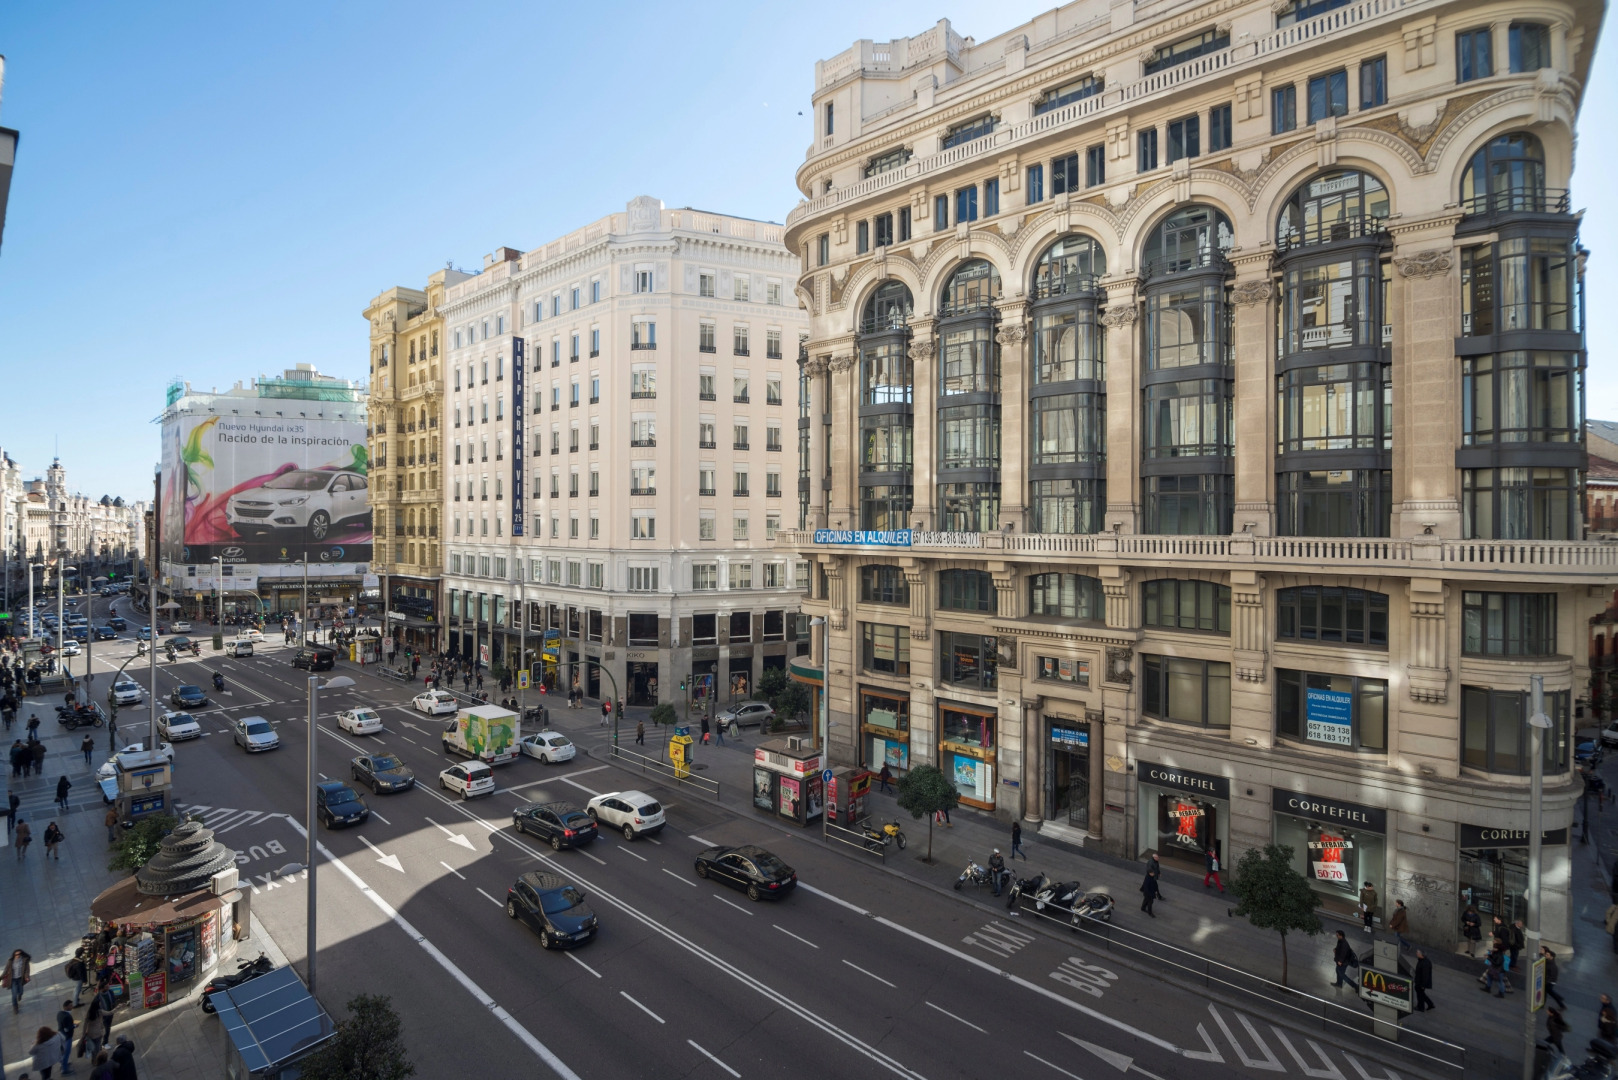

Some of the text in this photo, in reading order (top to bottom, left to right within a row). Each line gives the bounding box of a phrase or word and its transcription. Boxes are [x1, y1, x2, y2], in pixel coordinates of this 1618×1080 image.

[219, 422, 305, 433] Nuevo Hyundai ix35
[218, 432, 257, 444] Nacido
[261, 434, 274, 444] de
[278, 434, 288, 445] la
[514, 513, 522, 522] 25
[816, 531, 909, 544] OFICINAS EN ALQUILER
[1308, 692, 1351, 704] OFICINAS EN ALQUILER
[1308, 722, 1350, 735] 657 139 138
[1308, 730, 1350, 744] 618 183 171
[1150, 769, 1216, 791] CORTEFIEL
[1288, 798, 1369, 824] CORTEFIEL
[1175, 832, 1198, 846] 70%
[1480, 829, 1548, 840] CORTEFL
[961, 920, 1036, 959] TAXI
[1049, 956, 1119, 999] BUS
